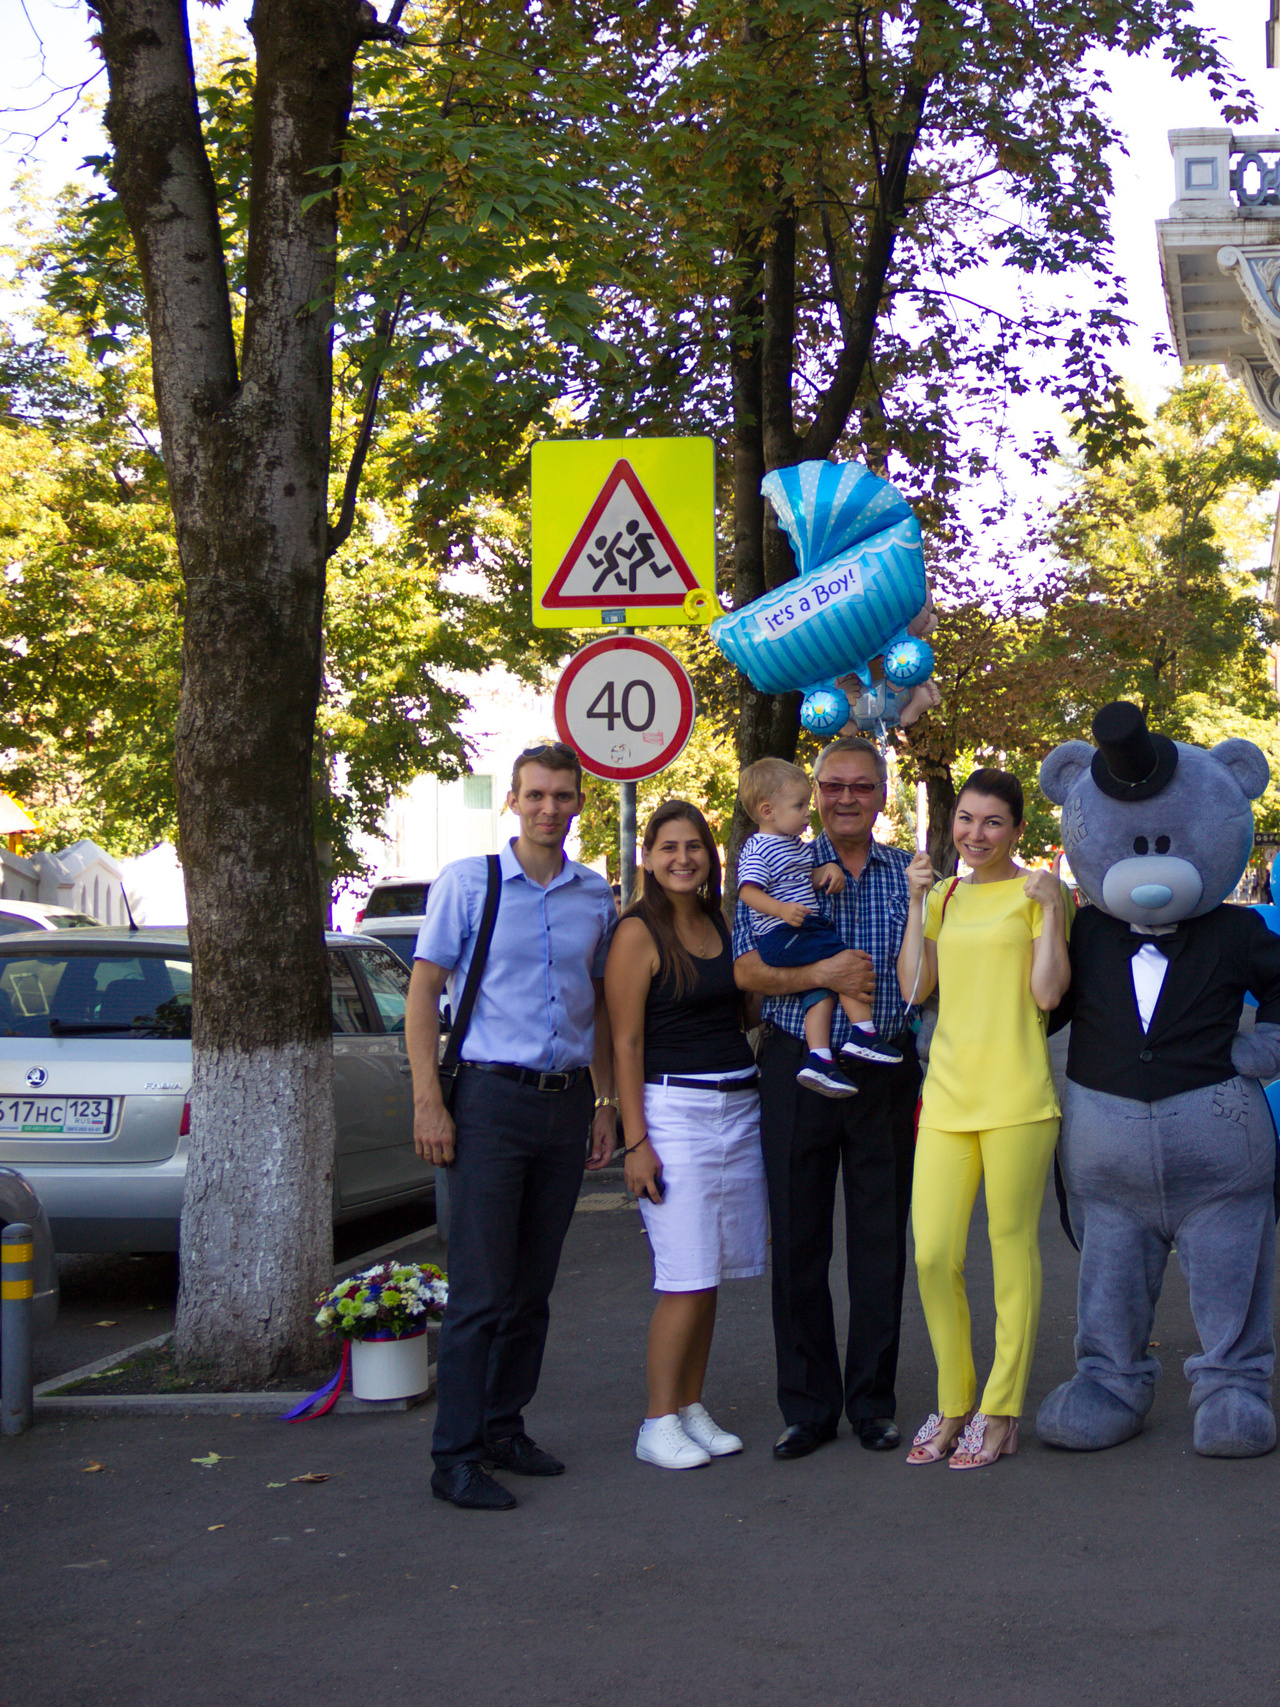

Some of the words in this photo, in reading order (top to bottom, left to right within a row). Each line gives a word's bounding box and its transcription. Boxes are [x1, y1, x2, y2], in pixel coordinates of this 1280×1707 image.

[765, 605, 795, 632] it's
[798, 597, 811, 612] a
[811, 568, 857, 606] Boy!
[586, 679, 656, 732] 40
[144, 1082, 183, 1090] FABIA
[69, 1100, 102, 1118] 123
[74, 1117, 92, 1125] RUS
